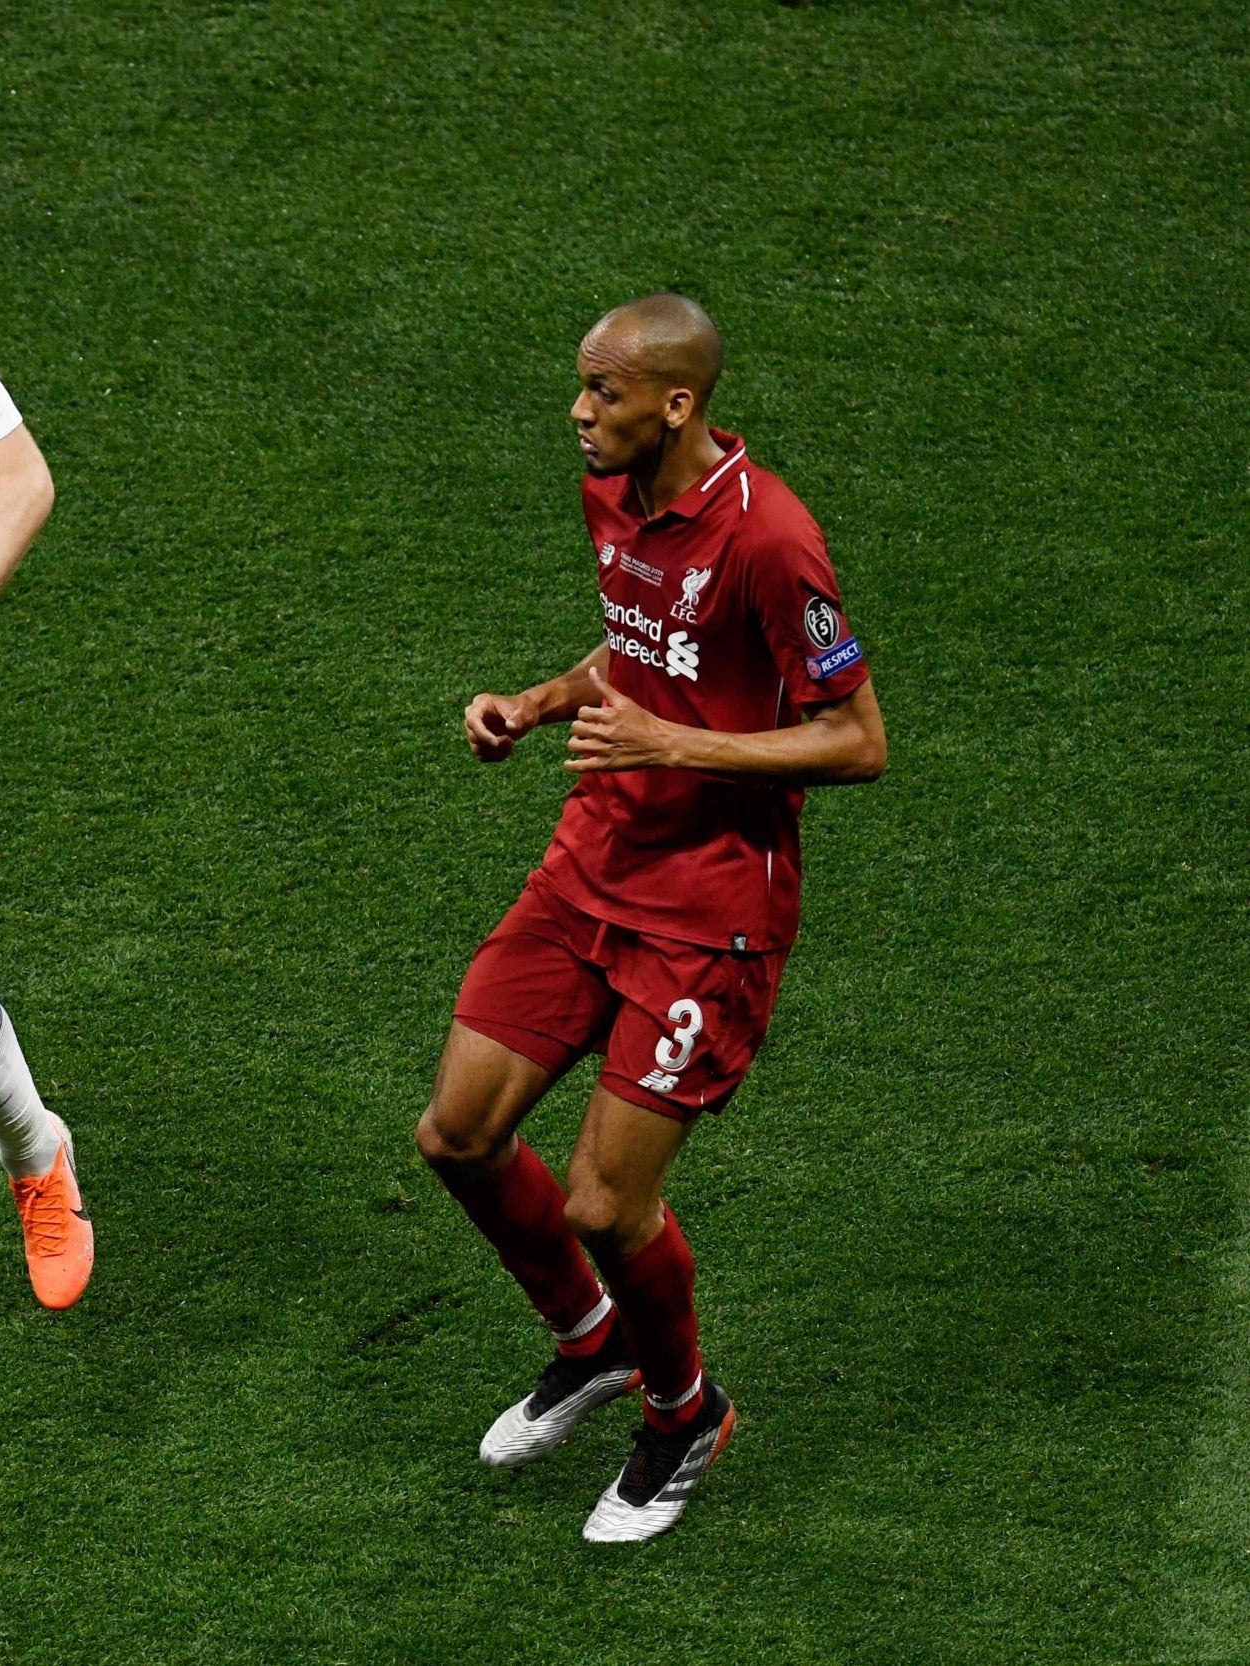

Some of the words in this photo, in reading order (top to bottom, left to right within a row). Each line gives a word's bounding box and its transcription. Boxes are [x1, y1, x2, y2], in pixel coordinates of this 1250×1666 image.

[819, 621, 829, 636] 5
[821, 643, 859, 672] RESPECT
[655, 998, 703, 1071] 3
